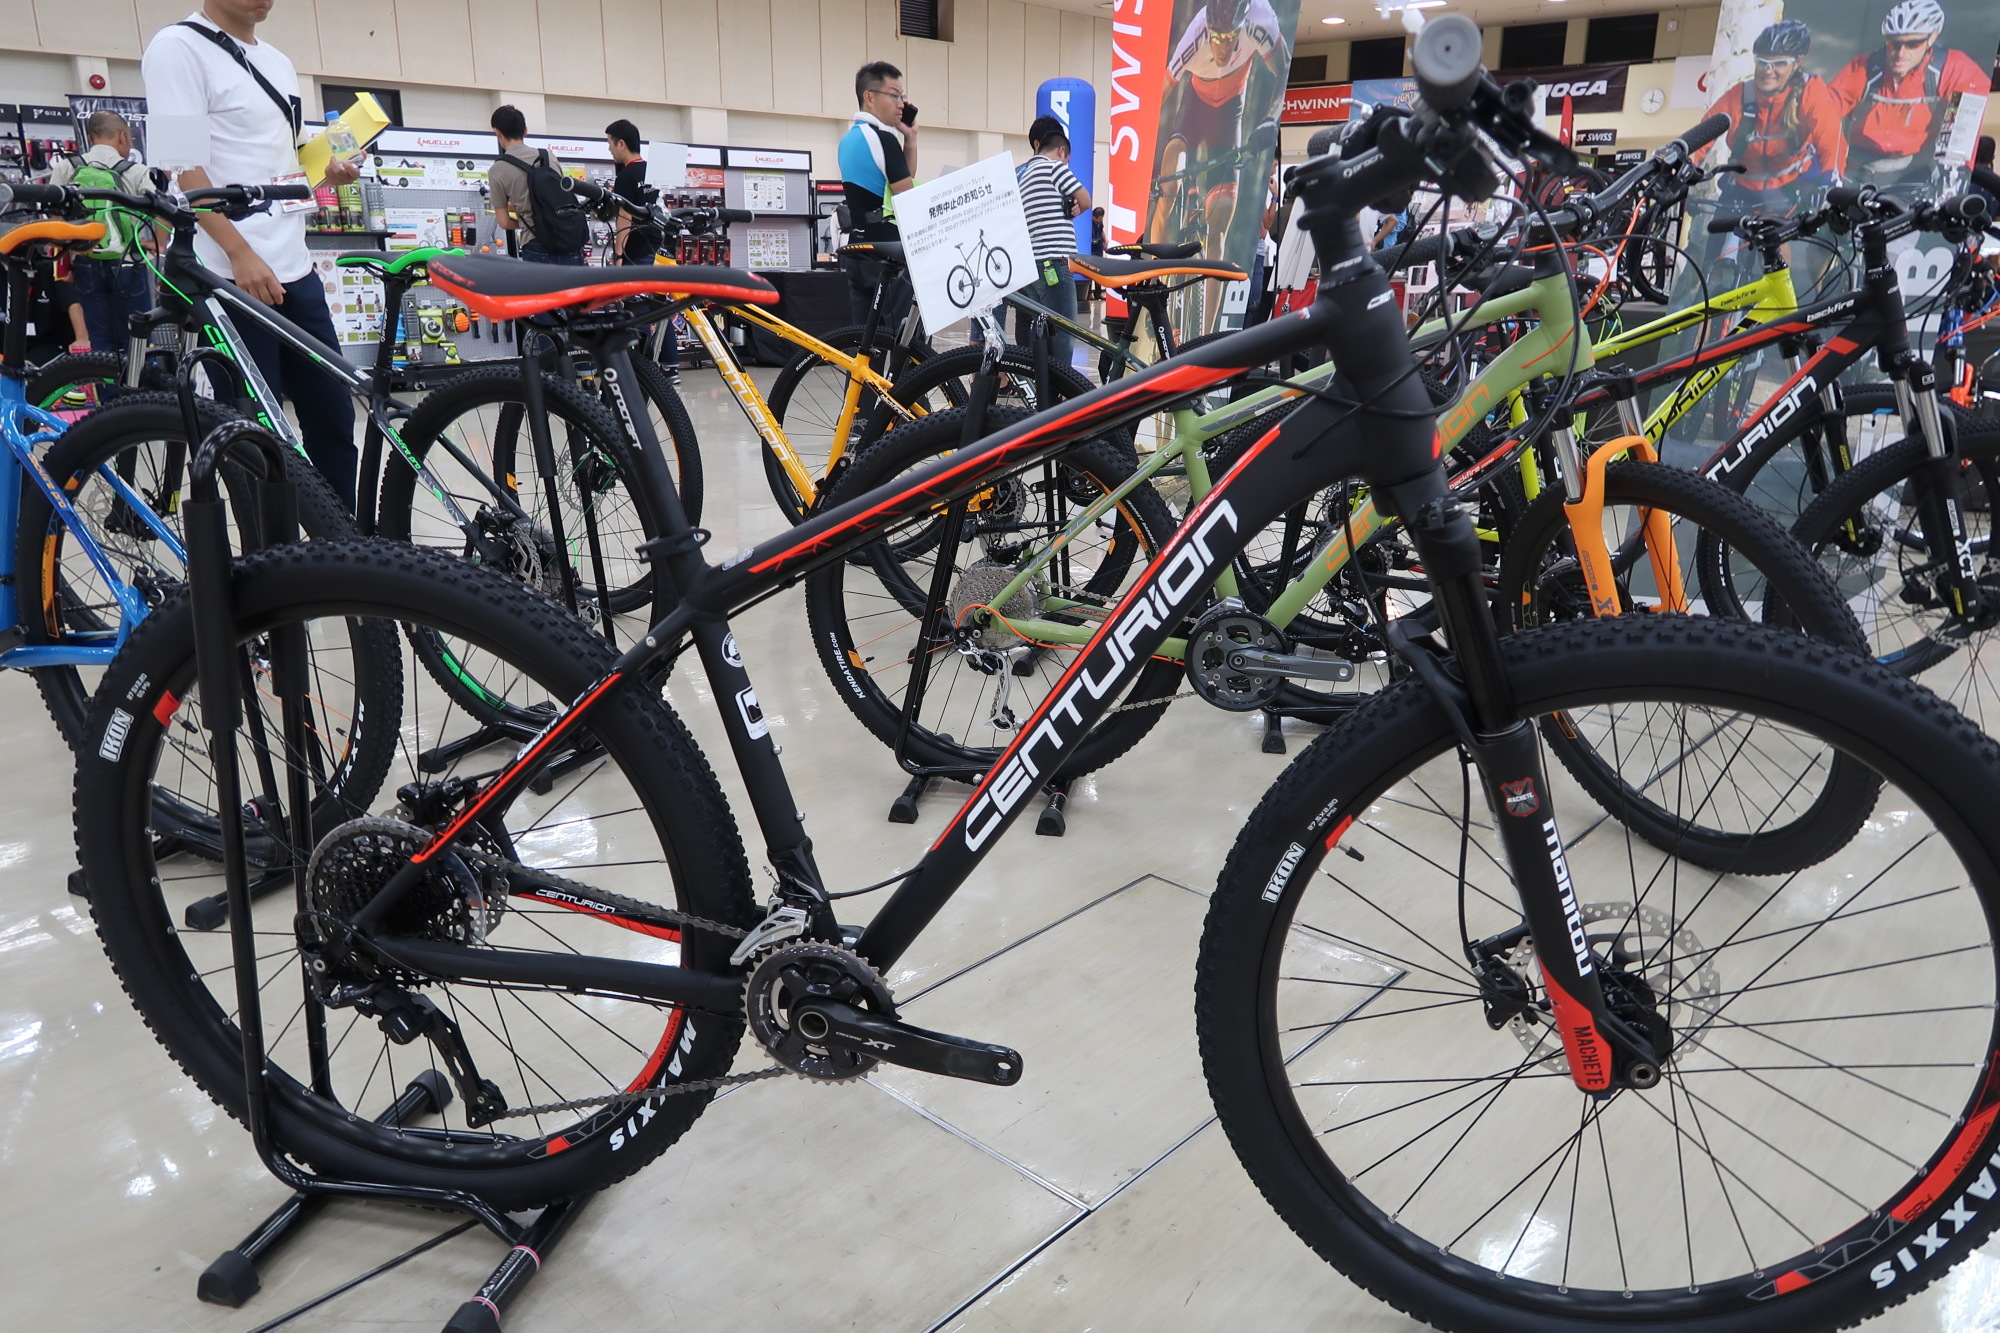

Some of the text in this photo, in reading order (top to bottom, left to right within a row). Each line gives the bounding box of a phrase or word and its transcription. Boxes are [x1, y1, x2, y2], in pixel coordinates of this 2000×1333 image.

[423, 139, 460, 147] MUELLER
[1586, 132, 1613, 142] SWISS
[928, 183, 993, 220] 発売中止のお知らせ
[1720, 288, 1757, 306] backfire
[1807, 299, 1854, 323] backfire
[696, 324, 789, 461] CENTURION
[608, 383, 643, 450] procraft
[387, 427, 422, 470] backfire pro
[1448, 464, 1481, 491] backfire
[1955, 540, 1977, 580] XCT
[829, 631, 867, 700] KENDATIRE.COM
[965, 498, 1239, 853] CENTURION
[99, 708, 134, 763] IKON
[1506, 790, 1535, 803] MACHETE
[1261, 841, 1306, 904] IKON
[535, 888, 616, 913] CENTURION
[1542, 817, 1594, 978] manitou
[658, 1016, 680, 1061] ALEXRIMS
[836, 1030, 896, 1051] DEORE XT
[1573, 1025, 1605, 1086] MACHETE
[1869, 1140, 2000, 1290] AXXIS
